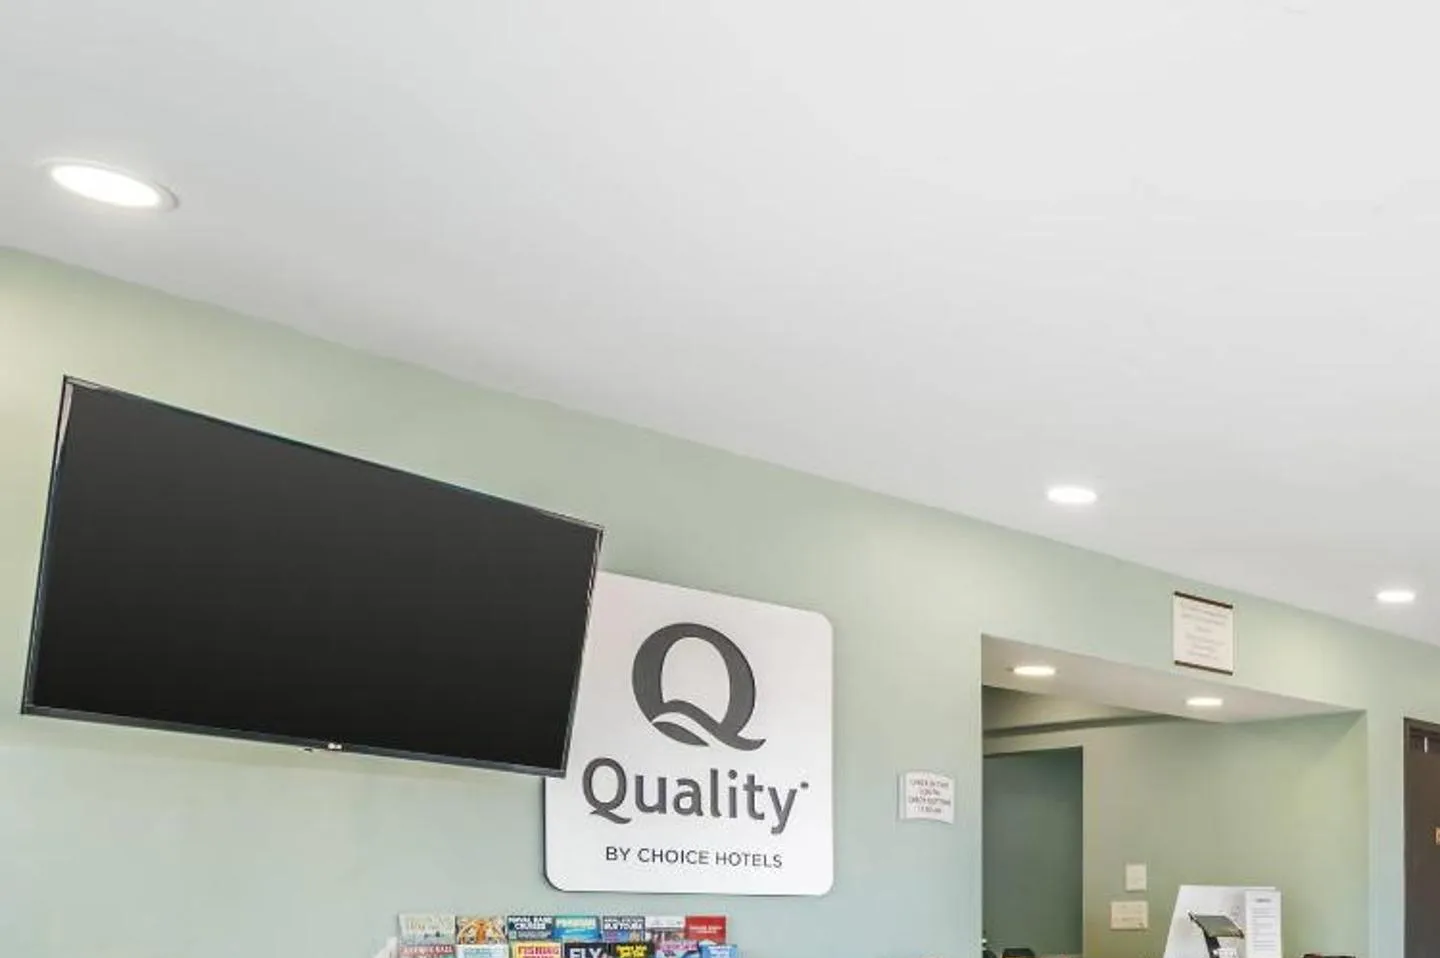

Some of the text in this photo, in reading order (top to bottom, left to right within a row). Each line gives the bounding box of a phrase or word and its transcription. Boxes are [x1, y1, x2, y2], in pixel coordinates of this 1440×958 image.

[632, 622, 767, 752] Q
[582, 756, 800, 835] Quality
[605, 845, 783, 869] BY CHOICE HOTELS
[518, 945, 560, 955] FISHING
